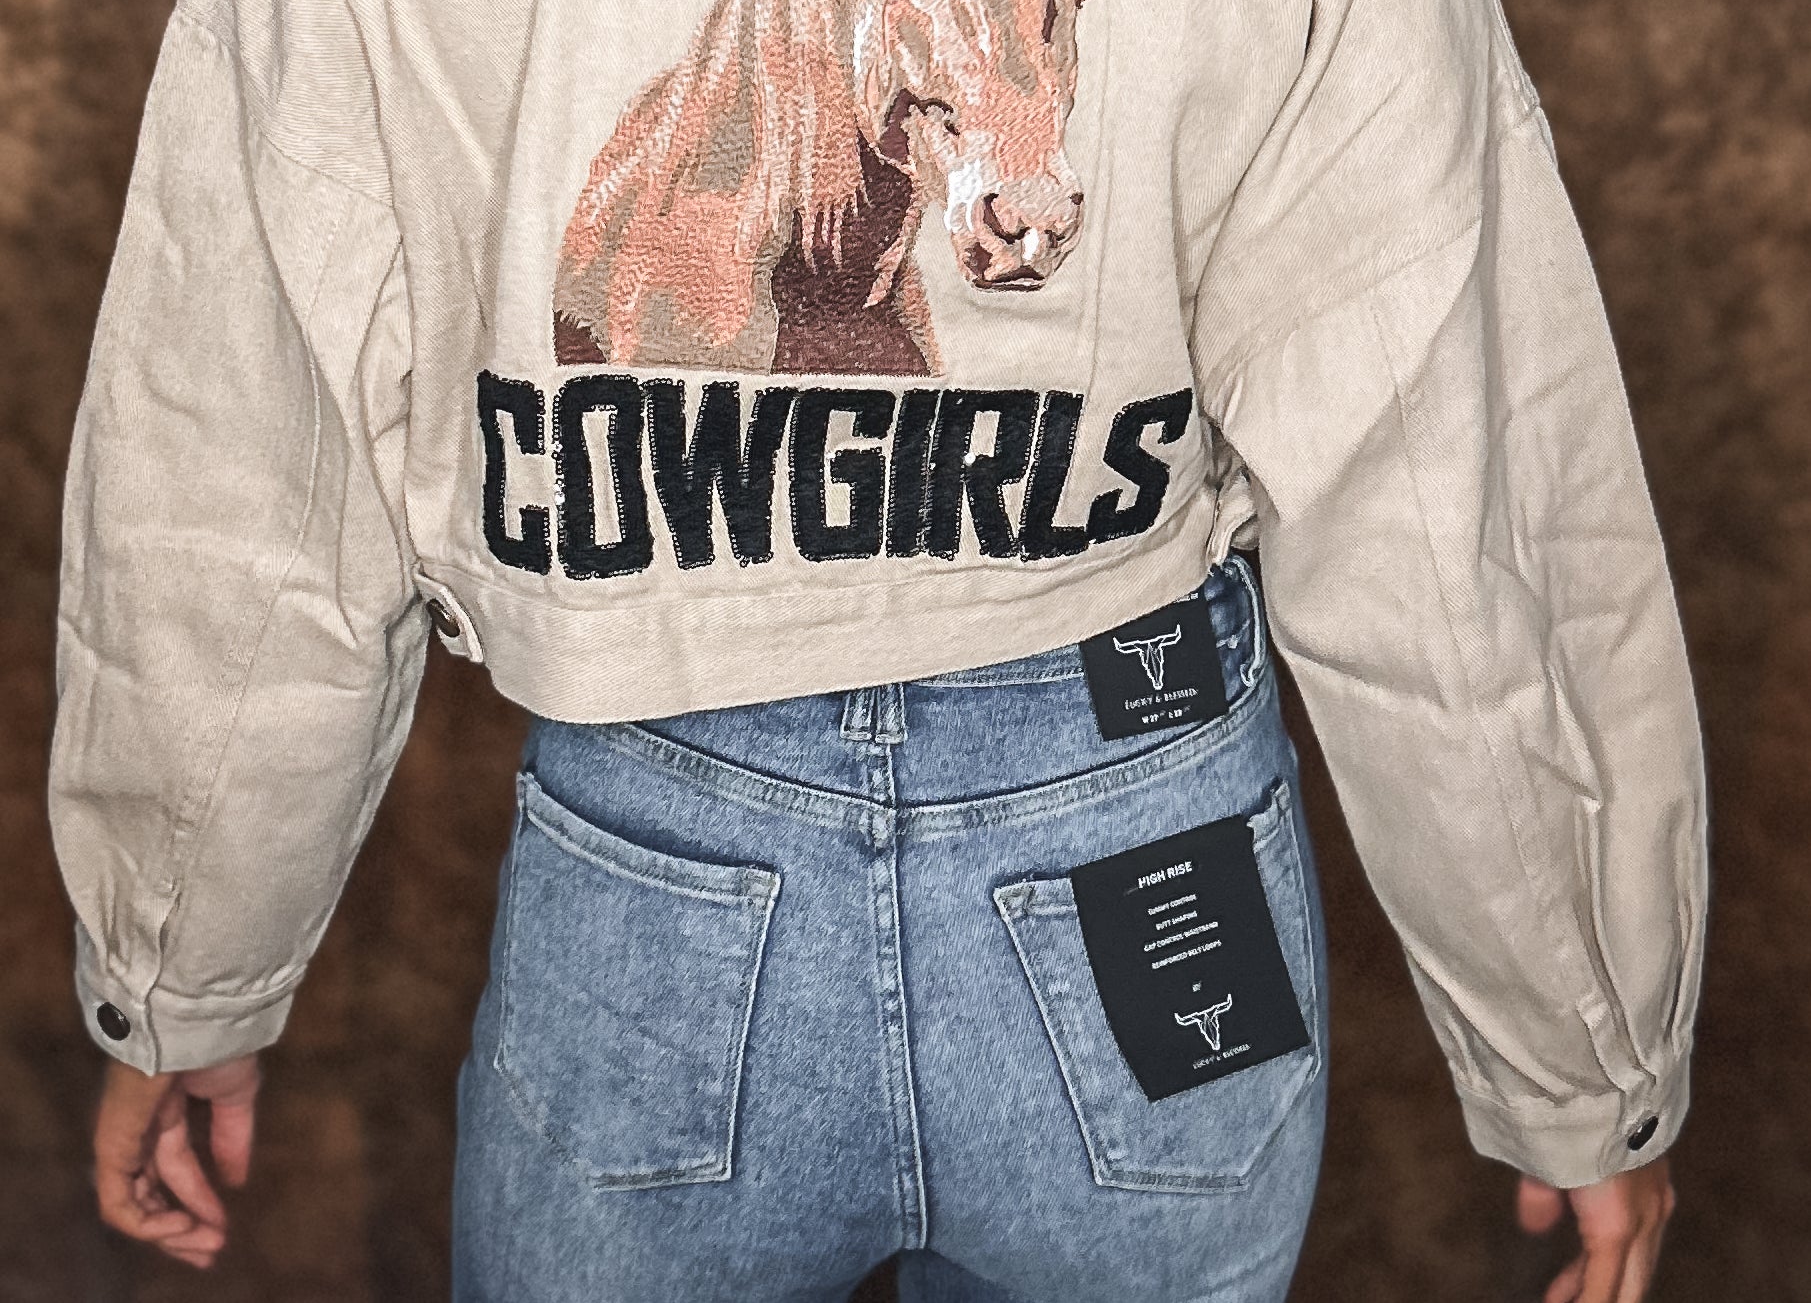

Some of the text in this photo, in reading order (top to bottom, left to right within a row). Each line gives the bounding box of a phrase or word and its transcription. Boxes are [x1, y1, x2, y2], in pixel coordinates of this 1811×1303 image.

[477, 370, 1194, 579] COWGIRLS
[1138, 861, 1192, 888] HIGH RISE
